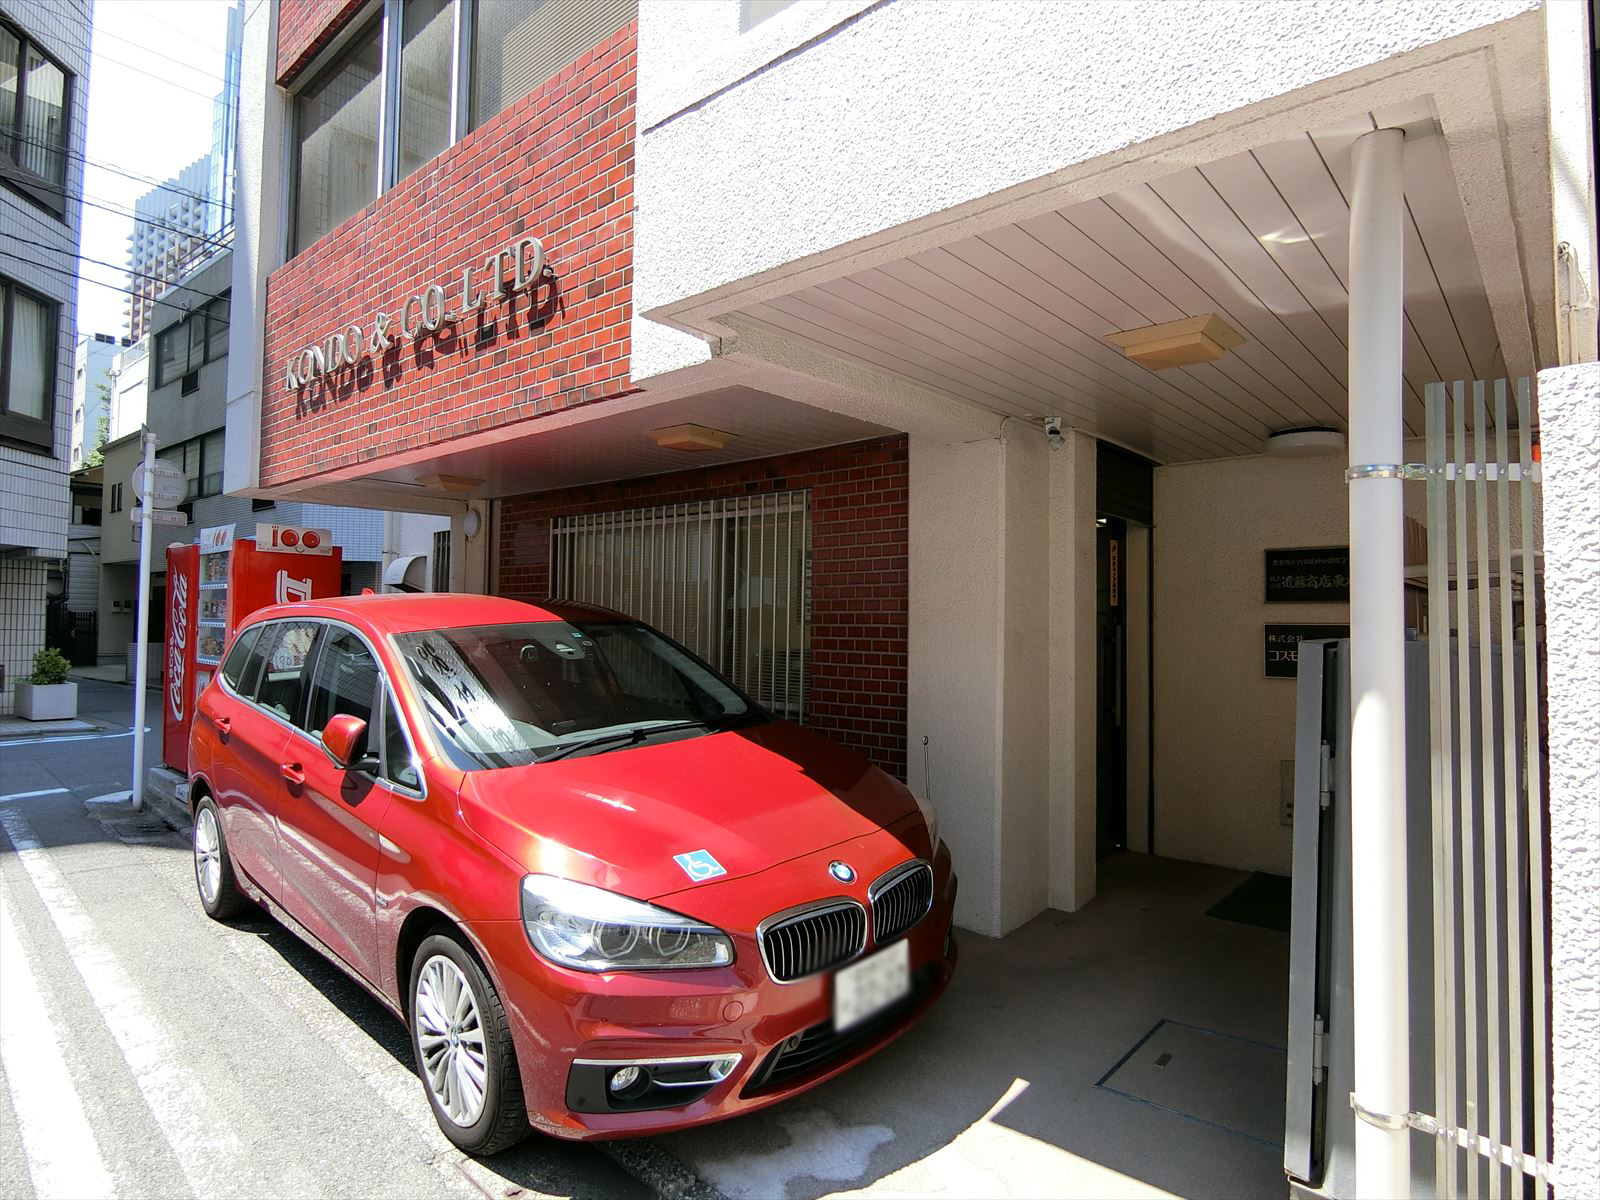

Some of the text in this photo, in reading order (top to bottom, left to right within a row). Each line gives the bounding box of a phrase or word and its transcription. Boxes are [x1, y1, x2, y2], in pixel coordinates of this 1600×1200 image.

[286, 325, 363, 391] KONDO
[370, 311, 392, 353] &
[170, 565, 188, 721] Coca-Cola
